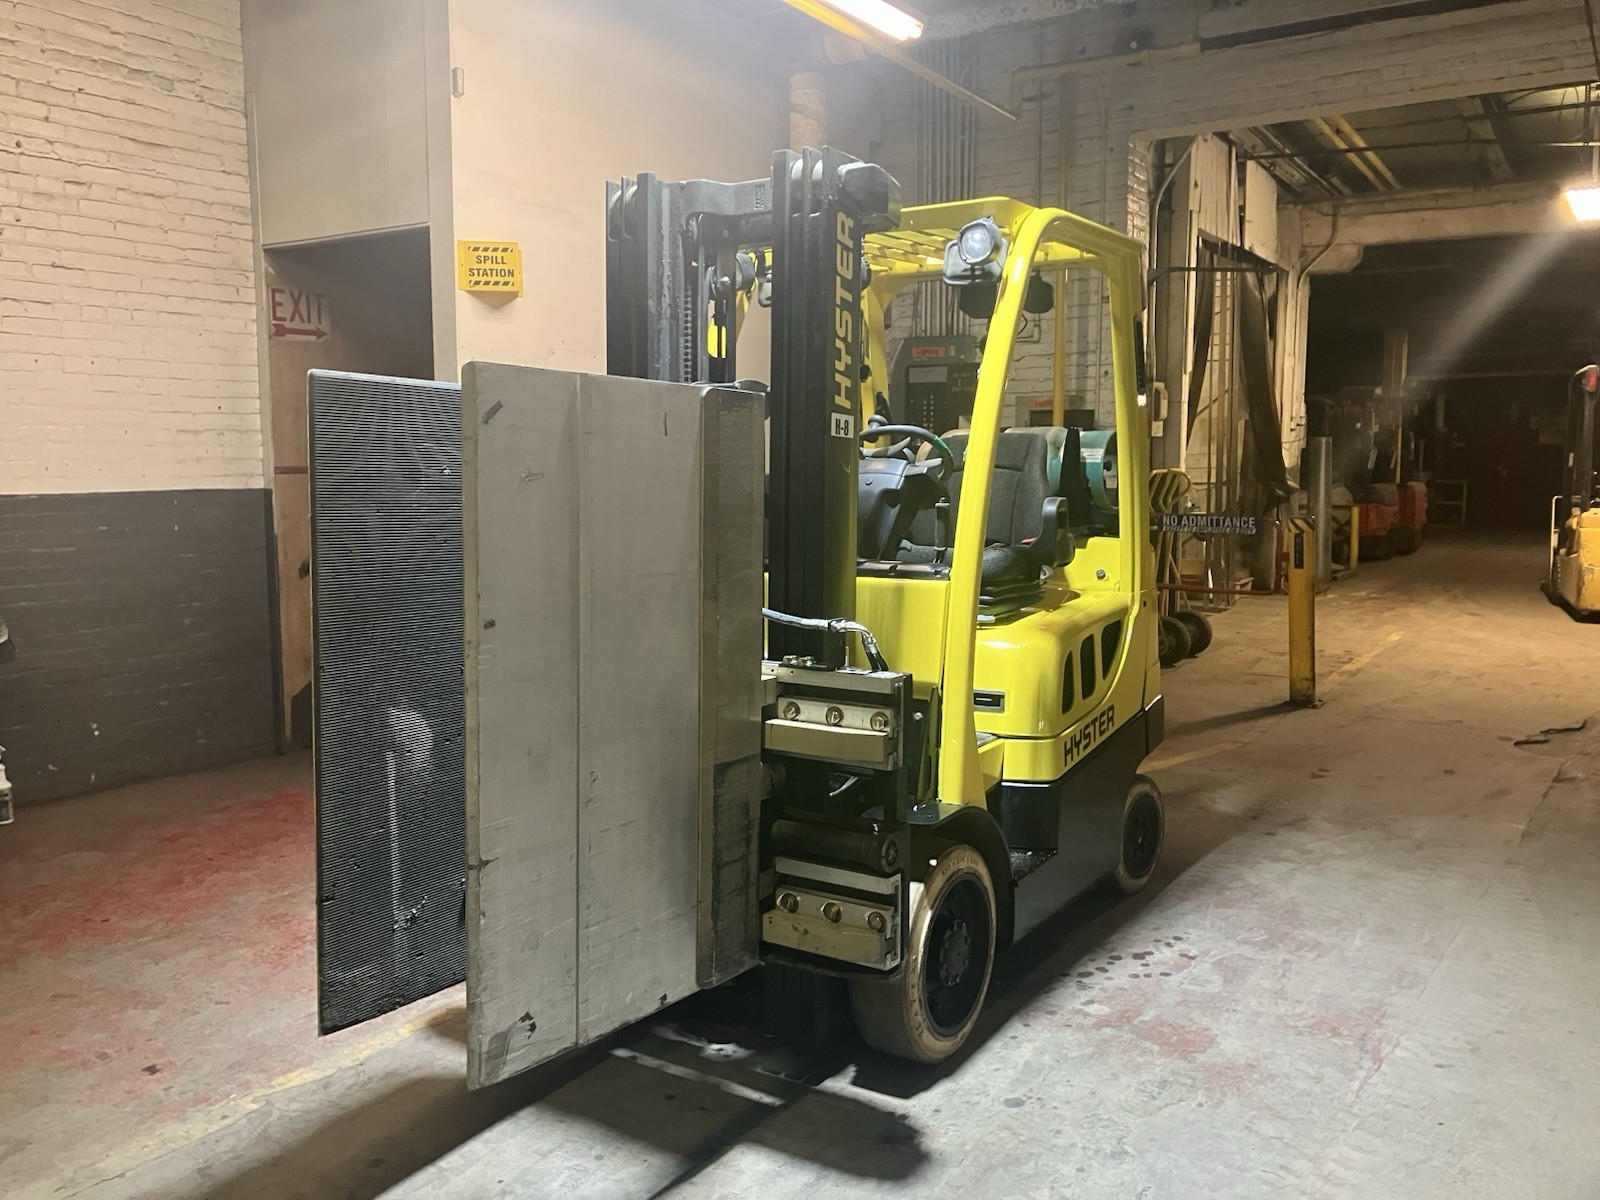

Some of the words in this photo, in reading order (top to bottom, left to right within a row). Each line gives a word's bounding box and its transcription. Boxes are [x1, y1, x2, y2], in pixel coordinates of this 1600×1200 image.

[475, 254, 507, 265] SPILL
[468, 267, 515, 278] STATION
[270, 287, 326, 325] EXIT
[834, 211, 854, 410] HYSTER
[835, 419, 850, 437] H-8
[1162, 514, 1178, 526] NO
[1181, 515, 1255, 528] ADMITTANCE
[1063, 704, 1115, 768] HYSTER
